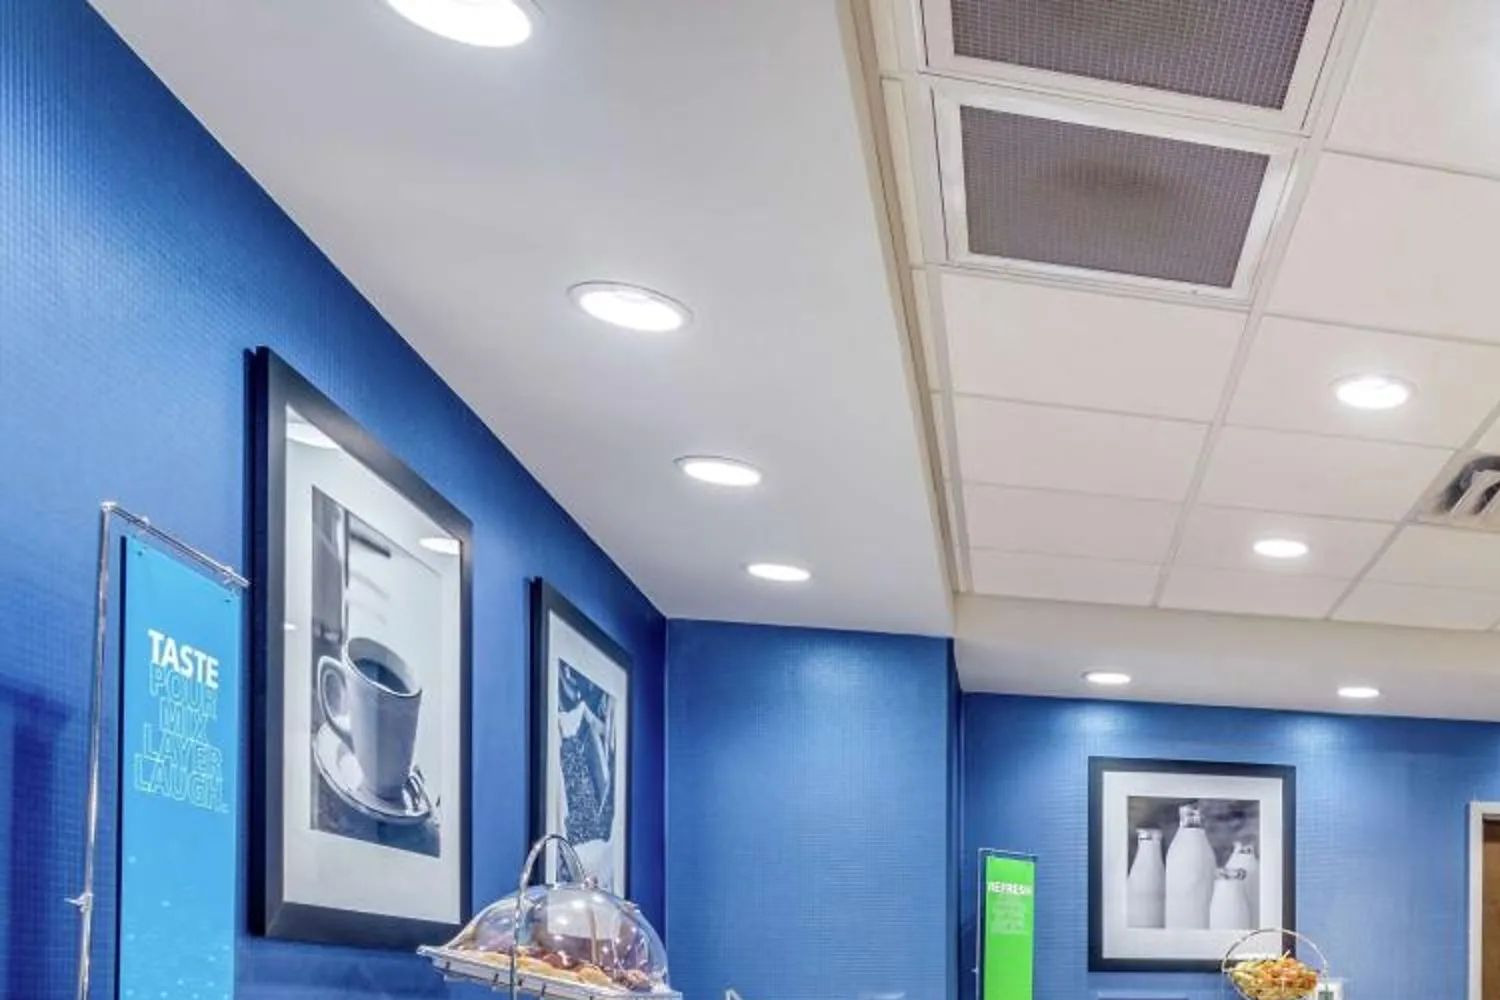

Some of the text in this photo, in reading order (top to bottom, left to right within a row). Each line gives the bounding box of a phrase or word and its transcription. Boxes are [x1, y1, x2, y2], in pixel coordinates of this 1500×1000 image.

[148, 628, 219, 690] TASTE
[159, 696, 209, 746] MIX
[143, 722, 223, 784] LAYER
